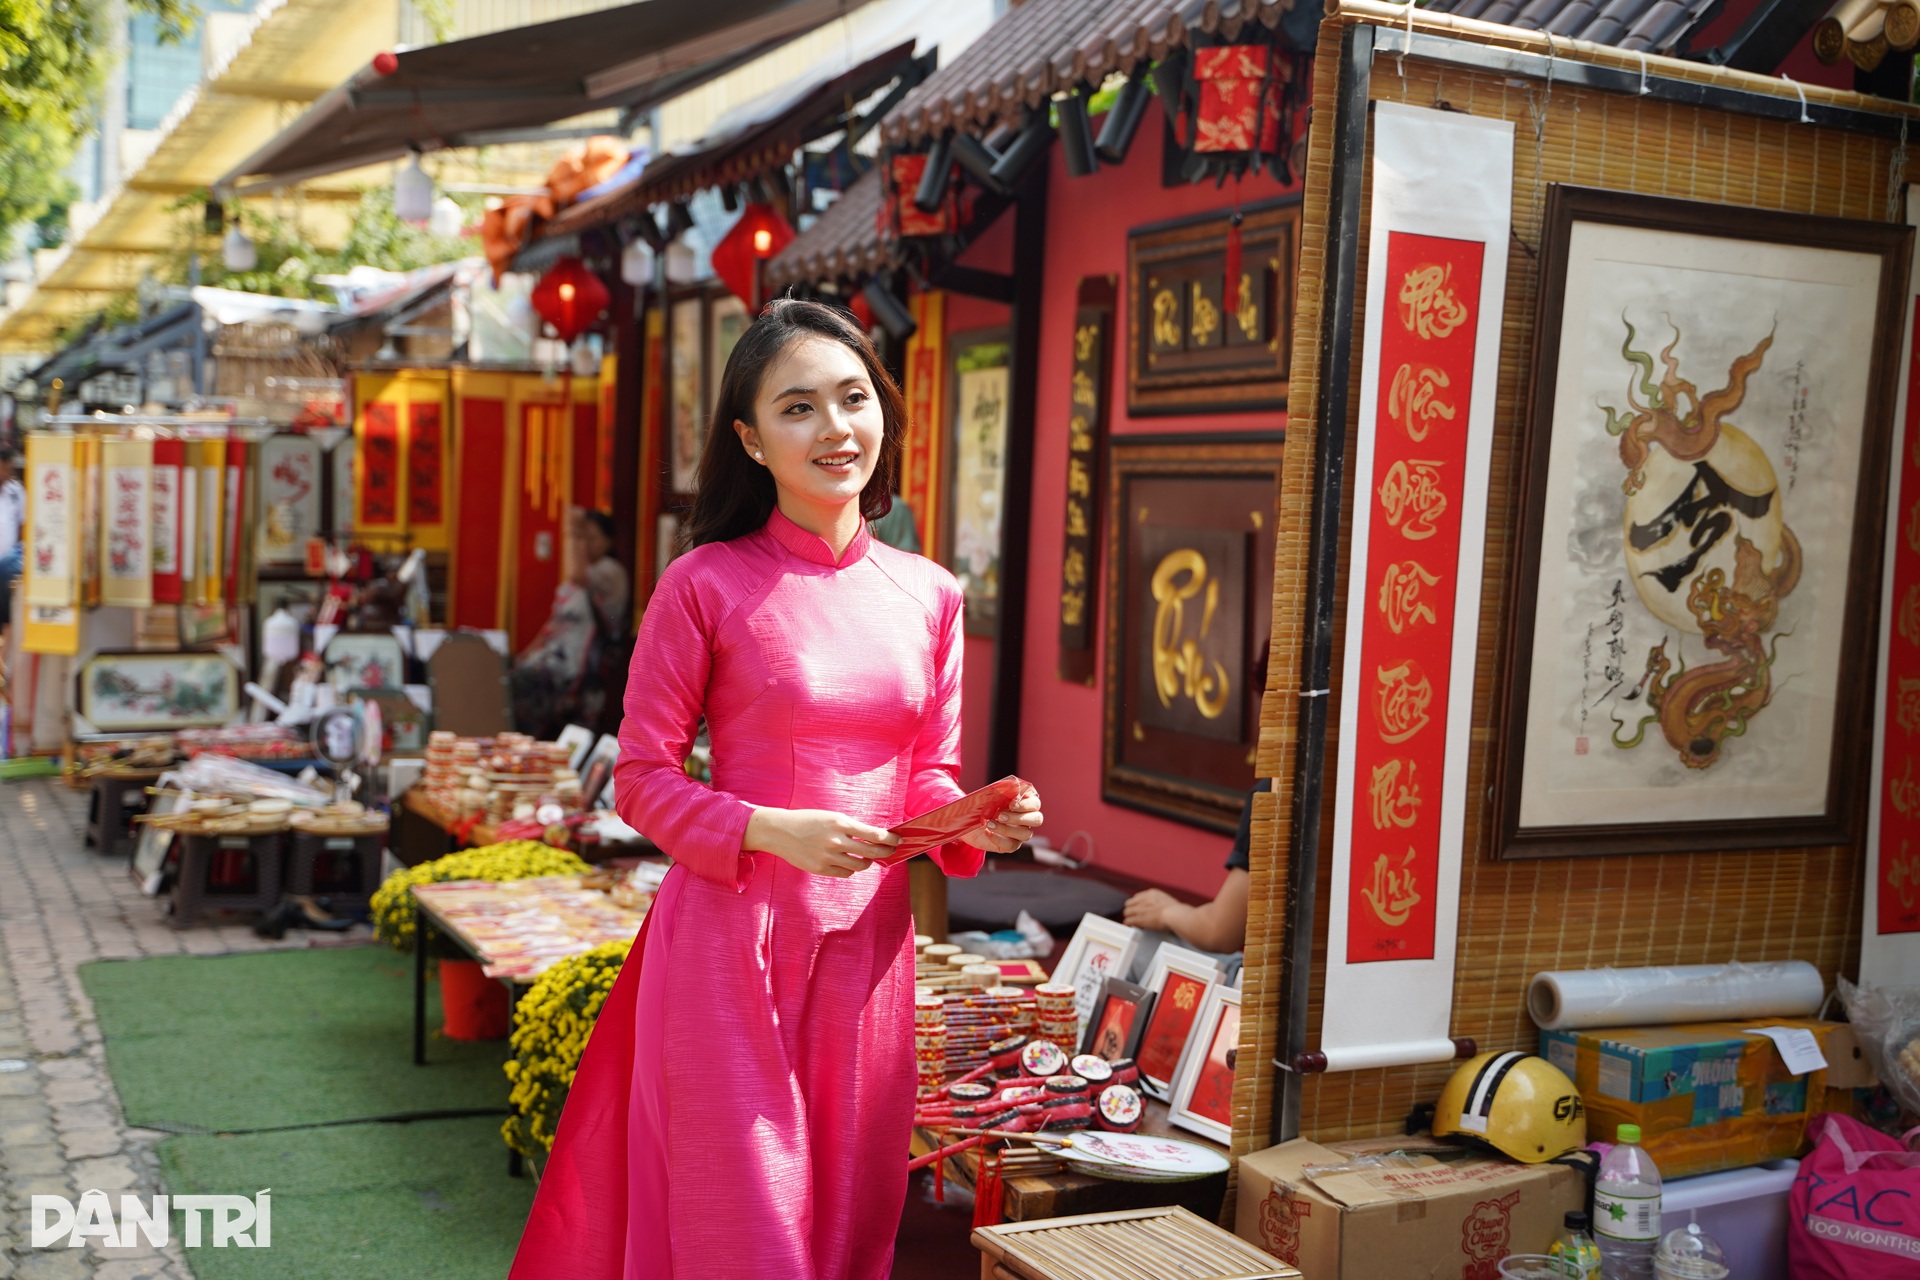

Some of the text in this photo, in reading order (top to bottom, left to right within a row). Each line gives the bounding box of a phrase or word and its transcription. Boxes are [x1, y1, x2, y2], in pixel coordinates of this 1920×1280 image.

[1473, 1217, 1505, 1234] Chupa
[1471, 1231, 1503, 1251] Chups
[1808, 1219, 1920, 1254] 100 MONTHS
